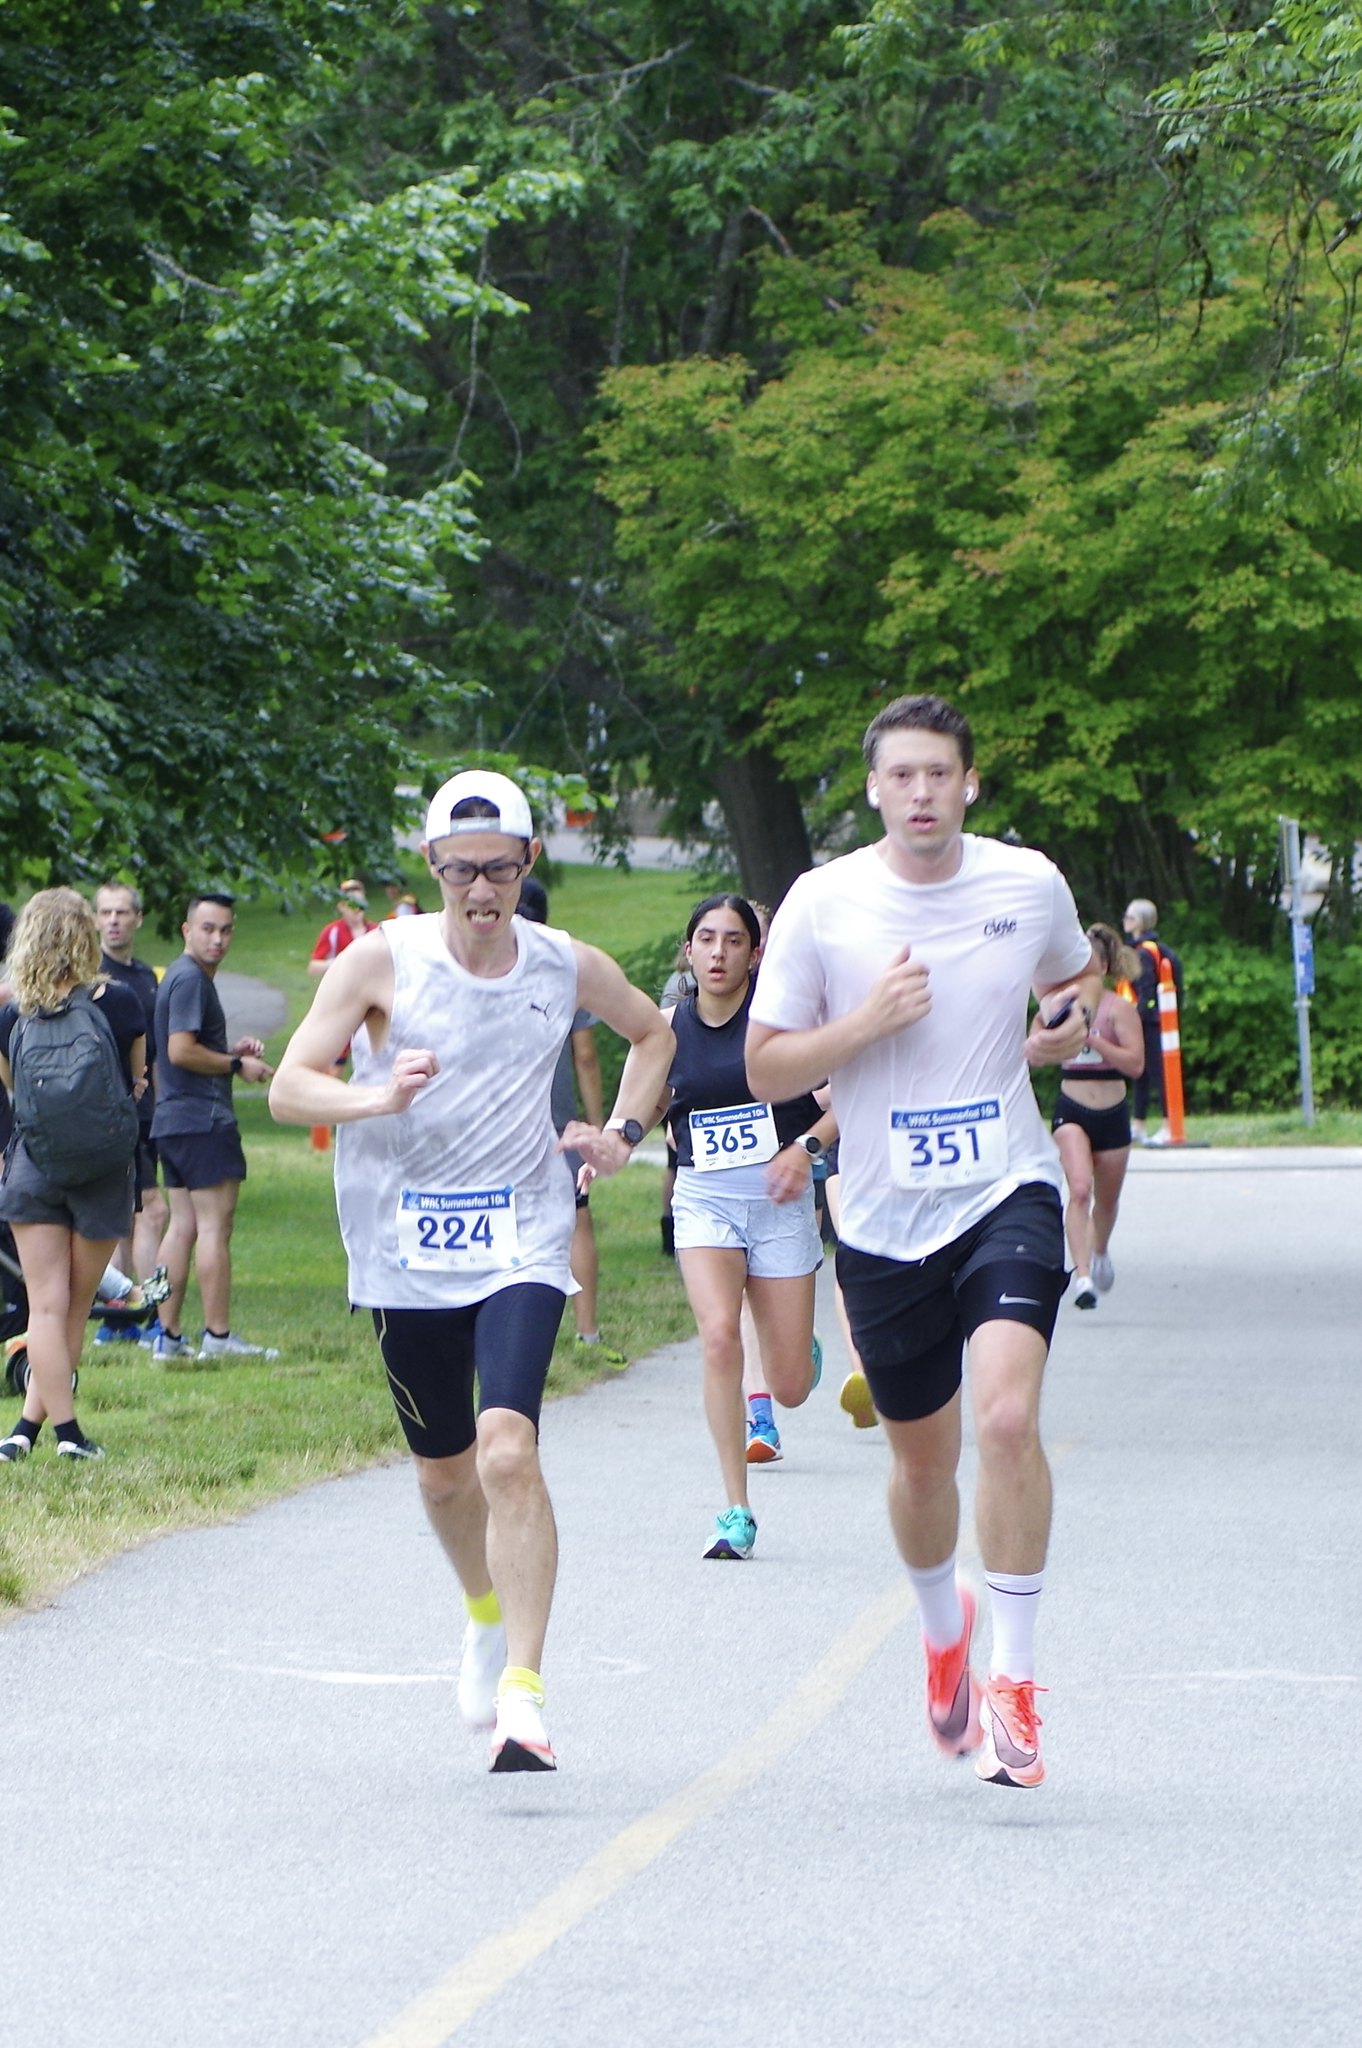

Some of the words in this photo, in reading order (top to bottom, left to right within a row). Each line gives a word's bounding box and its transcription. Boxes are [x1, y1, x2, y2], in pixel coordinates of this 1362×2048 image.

[703, 1123, 758, 1155] 365
[909, 1127, 980, 1167] 351
[417, 1213, 494, 1249] 224
